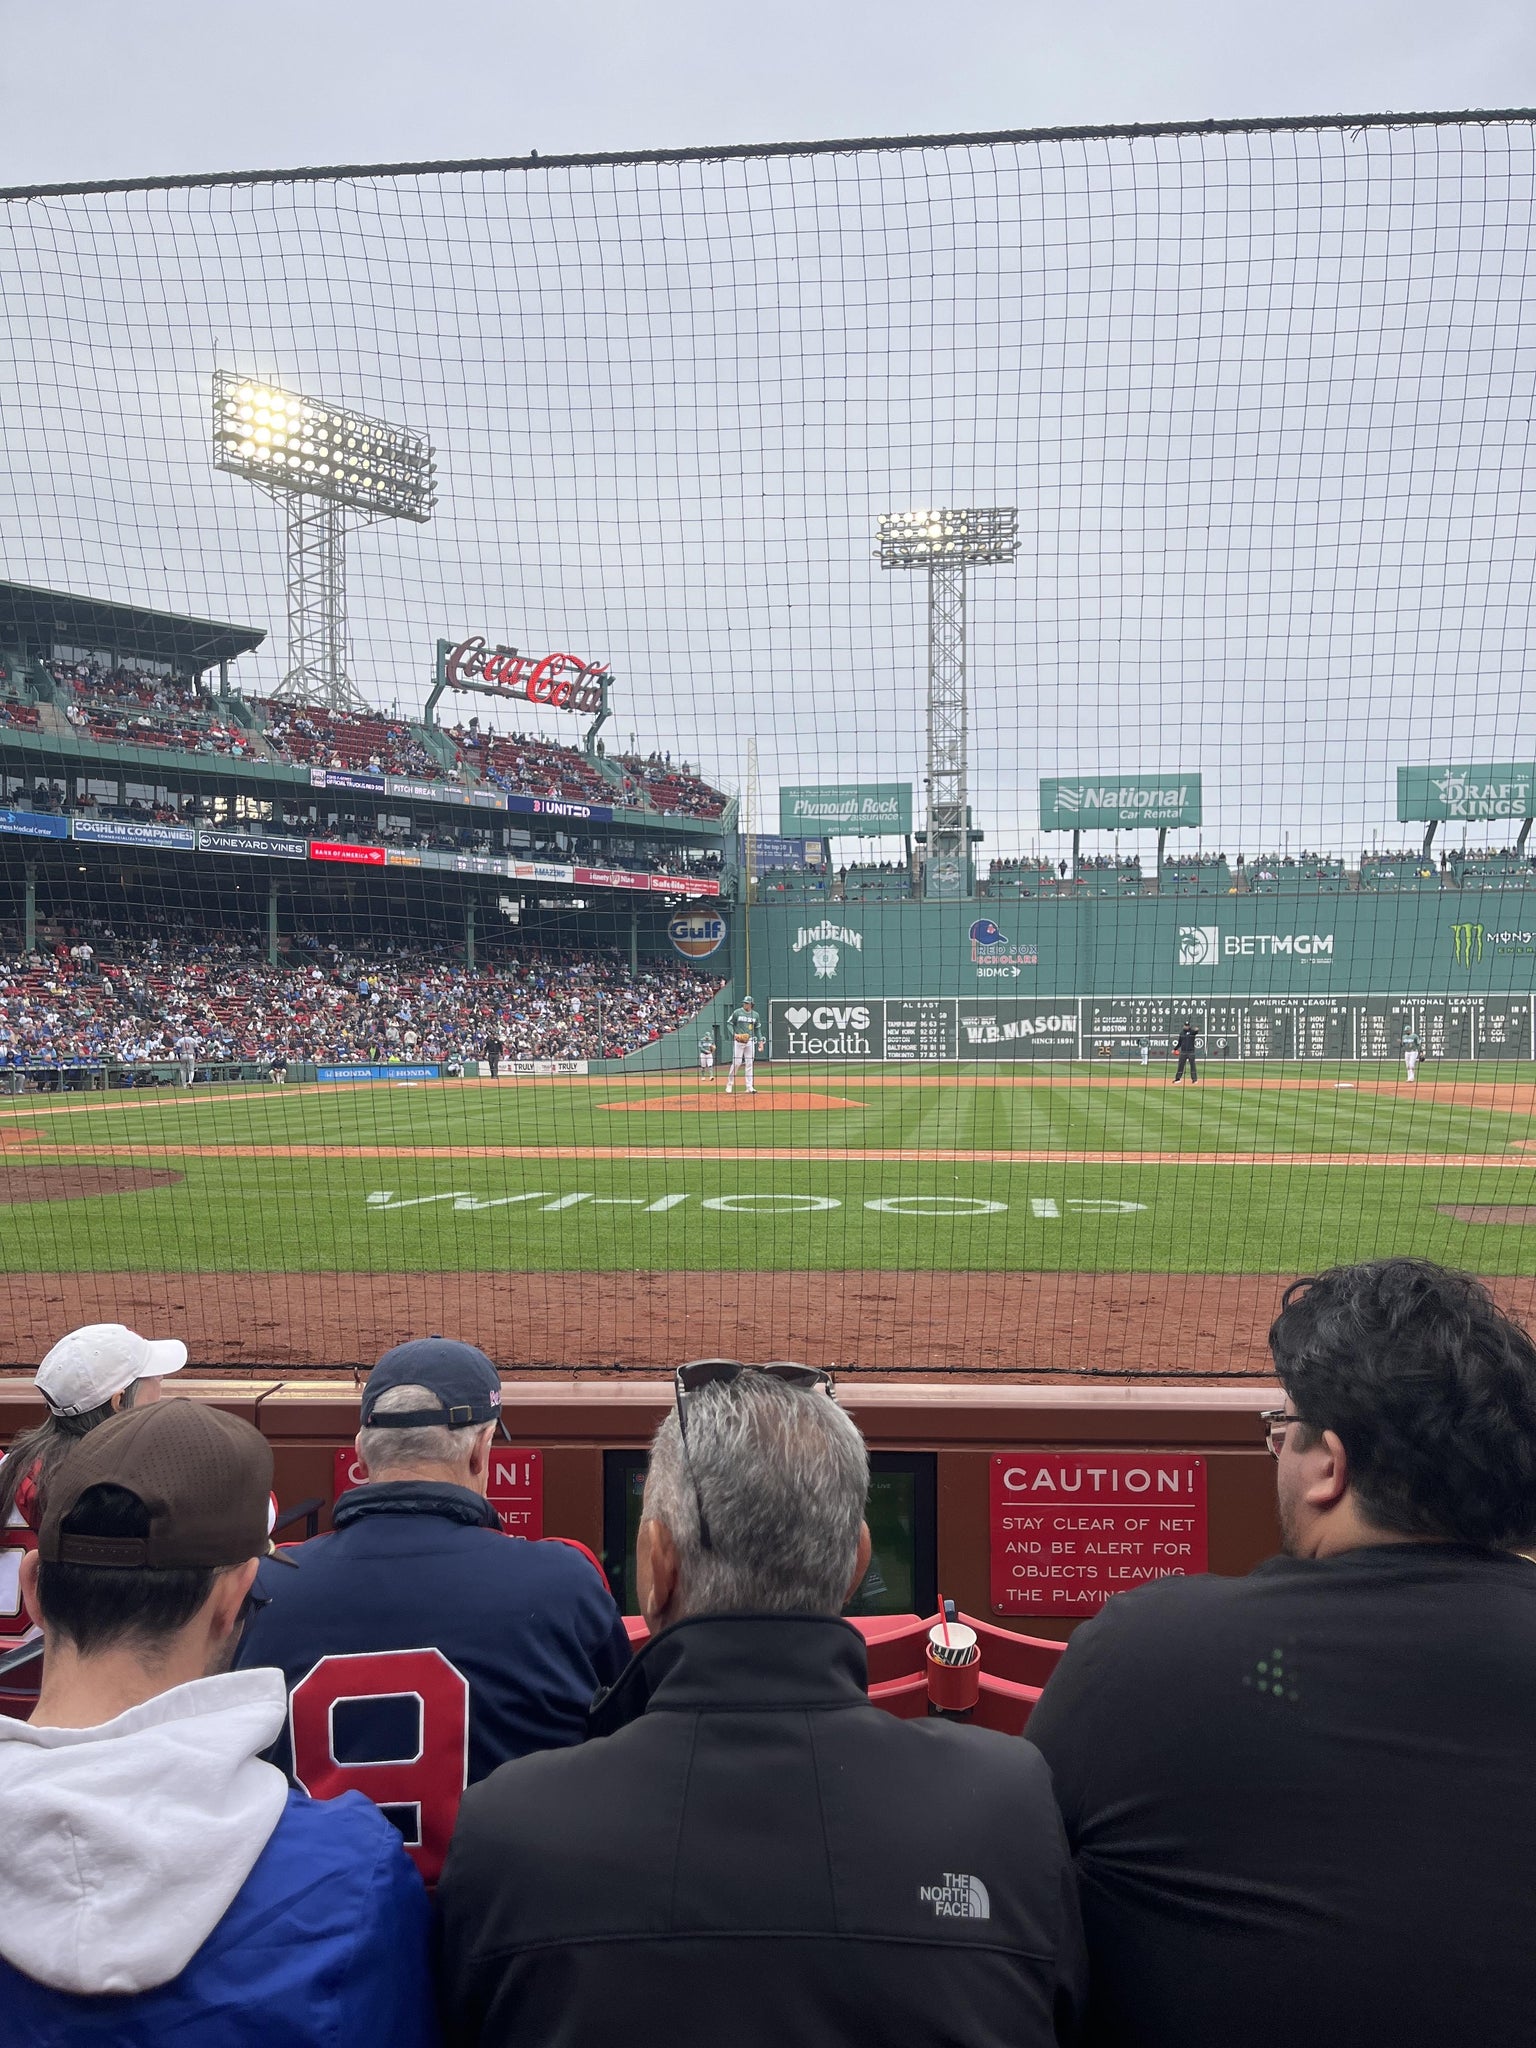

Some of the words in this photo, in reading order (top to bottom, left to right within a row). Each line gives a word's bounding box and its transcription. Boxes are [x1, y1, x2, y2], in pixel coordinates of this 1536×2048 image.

[446, 636, 610, 713] Coca-Cola
[394, 784, 414, 794] PITCH
[414, 786, 436, 796] BREAK
[1084, 786, 1187, 808] National
[1448, 784, 1530, 800] DRAFT
[546, 802, 590, 818] UNITED
[794, 799, 858, 815] Plymouth
[862, 798, 898, 813] Rock
[1120, 810, 1140, 819] Car
[1144, 808, 1182, 818] Rental
[1450, 800, 1526, 816] KINGS
[850, 812, 898, 822] assurance
[14, 825, 34, 833] Medical
[34, 827, 52, 835] Center
[75, 822, 126, 836] COGHLIN
[127, 826, 193, 840] COMPANIES
[212, 837, 268, 850] VINEYARD
[271, 843, 302, 853] VINES
[342, 850, 368, 859] AMERICA
[652, 879, 686, 890] Safelite
[672, 922, 722, 938] Gulf
[977, 945, 1006, 955] RED
[1010, 944, 1038, 955] SOX
[1224, 935, 1334, 954] BETMGM
[977, 955, 1038, 964] SCHOLARS
[977, 968, 1010, 977] BIDMC
[812, 1006, 870, 1030] CVS
[981, 1017, 996, 1025] BUT
[788, 1032, 871, 1054] Health
[1003, 1467, 1194, 1493] CAUTION!
[1002, 1518, 1044, 1530] STAY
[1053, 1518, 1115, 1531] CLEAR
[1124, 1518, 1150, 1532] OF
[1160, 1519, 1196, 1532] NET
[1005, 1542, 1042, 1554] AND
[1051, 1542, 1076, 1554] BE
[1084, 1543, 1144, 1555] ALERT
[1153, 1544, 1192, 1556] FOR
[1012, 1565, 1098, 1579] OBJECTS
[1006, 1589, 1043, 1601] THE
[1052, 1590, 1126, 1602] PLAYIN
[289, 1647, 469, 1895] 9
[943, 1872, 968, 1888] THE
[920, 1886, 969, 1902] NORTH
[936, 1901, 968, 1917] FACE
